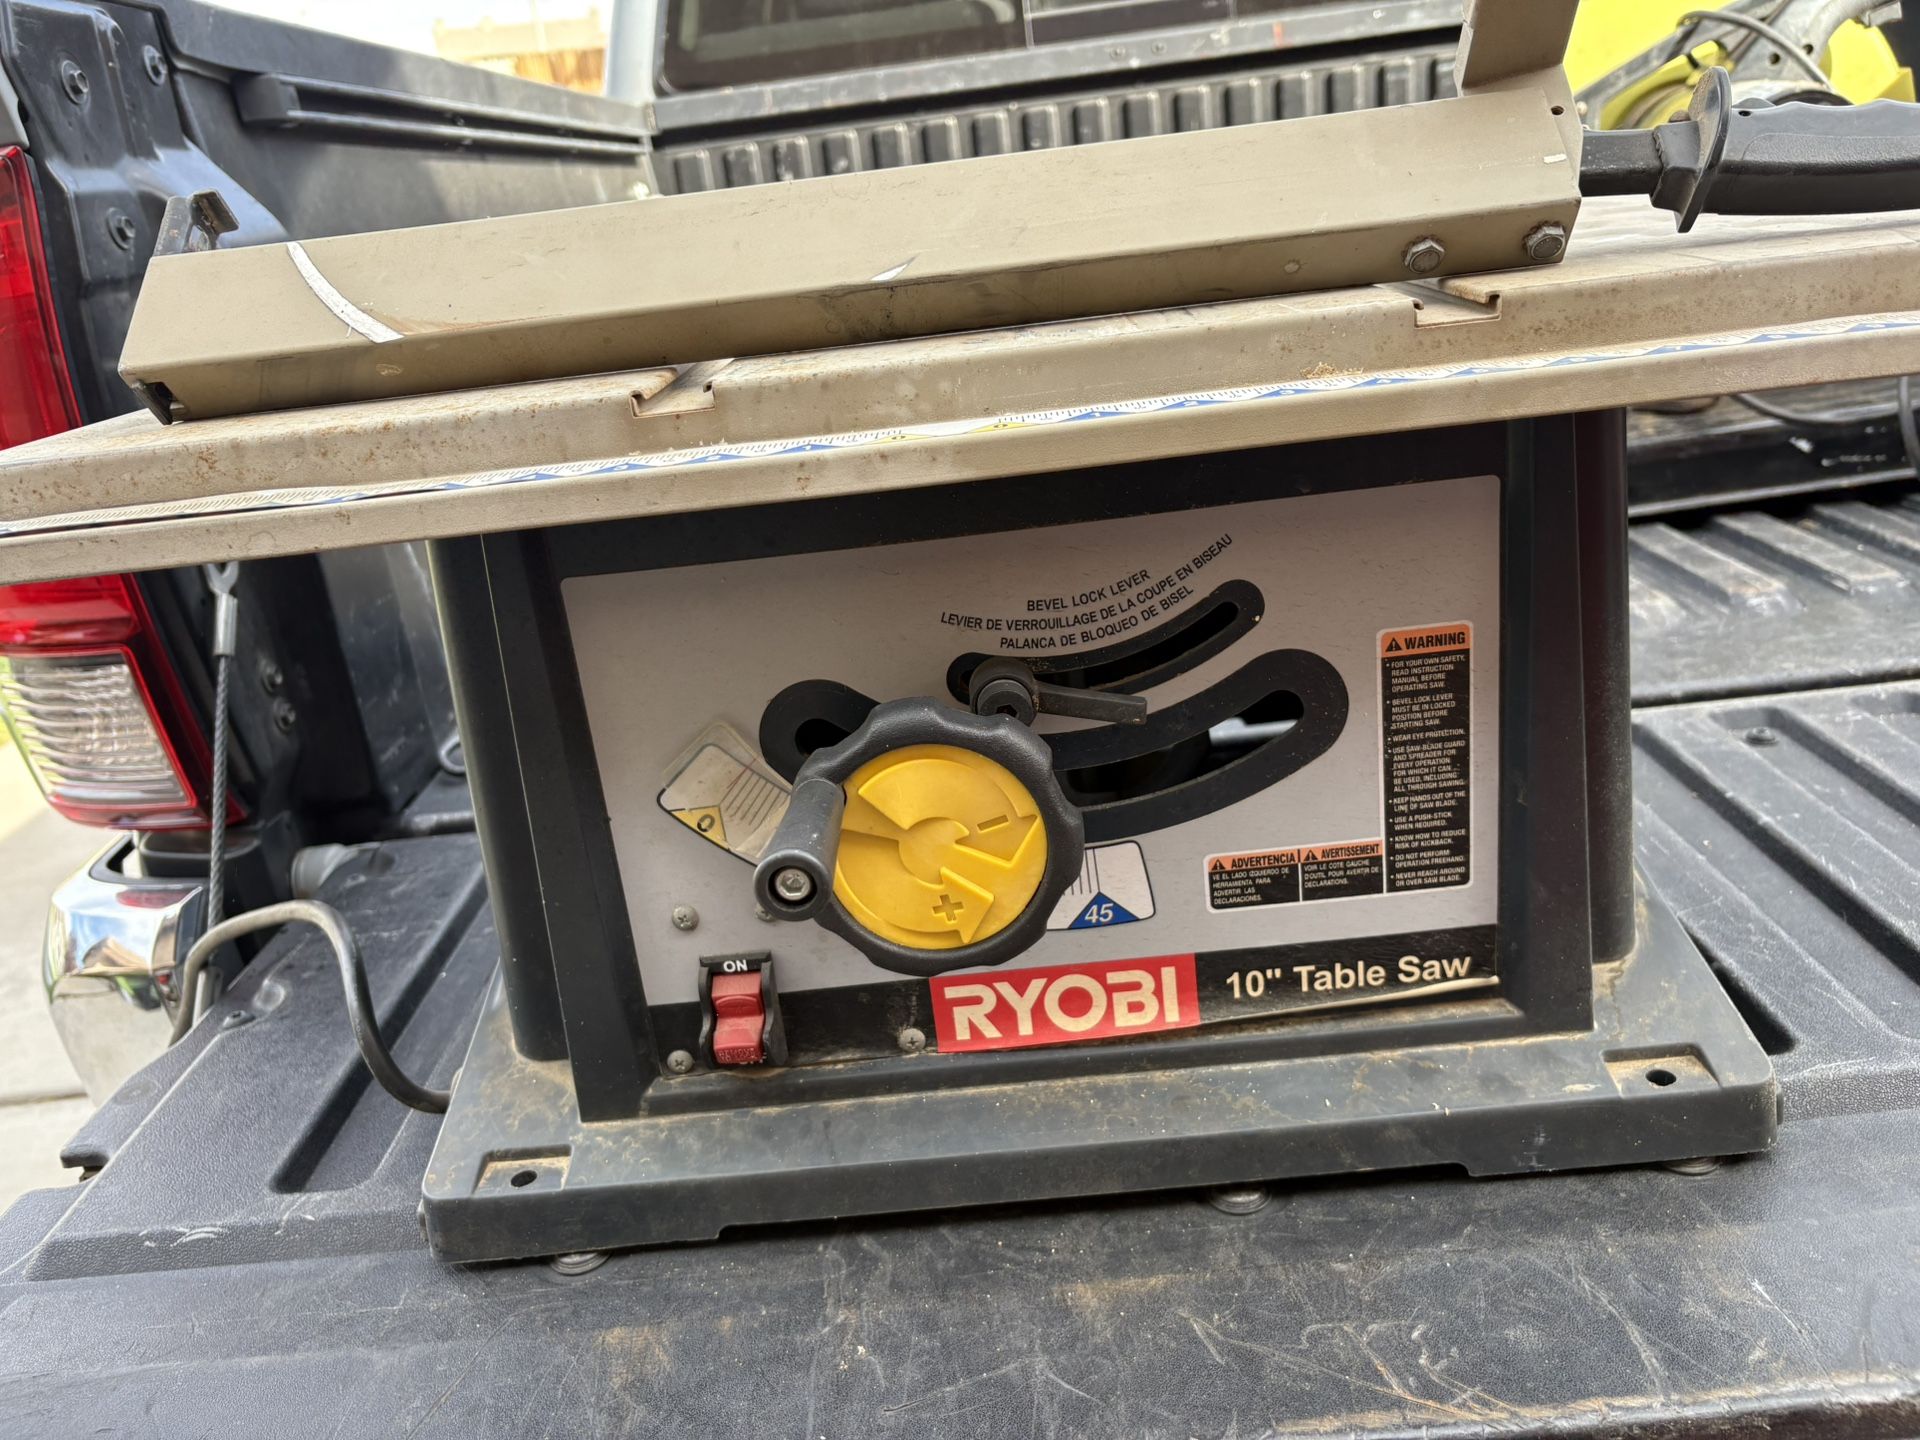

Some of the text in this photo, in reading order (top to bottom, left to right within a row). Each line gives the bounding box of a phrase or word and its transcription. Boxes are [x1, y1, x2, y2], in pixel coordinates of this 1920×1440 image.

[940, 534, 1233, 631] LEVIER DE VERROUILLAGE DE LA COUPE EN BISEAU
[1026, 569, 1150, 612] BEVEL LOCK LEVER
[1000, 586, 1194, 650] PALANCA DE BLOQUEO DE BISEL
[1405, 632, 1465, 650] WARNING
[1392, 660, 1404, 668] FOR
[1406, 659, 1422, 667] YOUR
[1424, 657, 1439, 665] OWN
[1411, 664, 1454, 674] INSTRUCTION
[1421, 673, 1446, 681] BEFORE
[1392, 683, 1428, 692] OPERATING
[1392, 698, 1413, 706] BEVEL
[1432, 693, 1452, 701] LEVER
[1430, 701, 1456, 709] LOCKED
[1424, 710, 1448, 718] BEFORE
[1392, 720, 1424, 729] STARTING
[1392, 734, 1411, 742] WEAR
[1393, 746, 1405, 754] USE
[1444, 741, 1465, 749] GUARD
[1409, 751, 1442, 760] SPREADER
[1415, 758, 1450, 767] OPERATION
[1424, 772, 1457, 782] INCLUDING
[1408, 782, 1437, 791] THROUGH
[1394, 804, 1408, 812] LINE
[697, 814, 715, 832] 0
[1395, 834, 1414, 842] KNOW
[1415, 832, 1429, 840] HOW
[1321, 844, 1380, 859] AVERTISSEMENT
[1420, 850, 1450, 858] PERFORM
[1231, 854, 1295, 869] ADVERTENCIA
[1346, 859, 1370, 867] GAUCHE
[1395, 859, 1429, 868] OPERATION
[1249, 869, 1279, 877] IZQUIERDO
[1346, 868, 1369, 876] AVERTIR
[1440, 867, 1465, 875] AROUND
[1213, 879, 1253, 888] HERRAMIENTA
[1084, 902, 1115, 924] 45
[723, 959, 748, 972] ON
[1226, 956, 1471, 1000] 10" Table Saw
[944, 966, 1180, 1041] RYOBI
